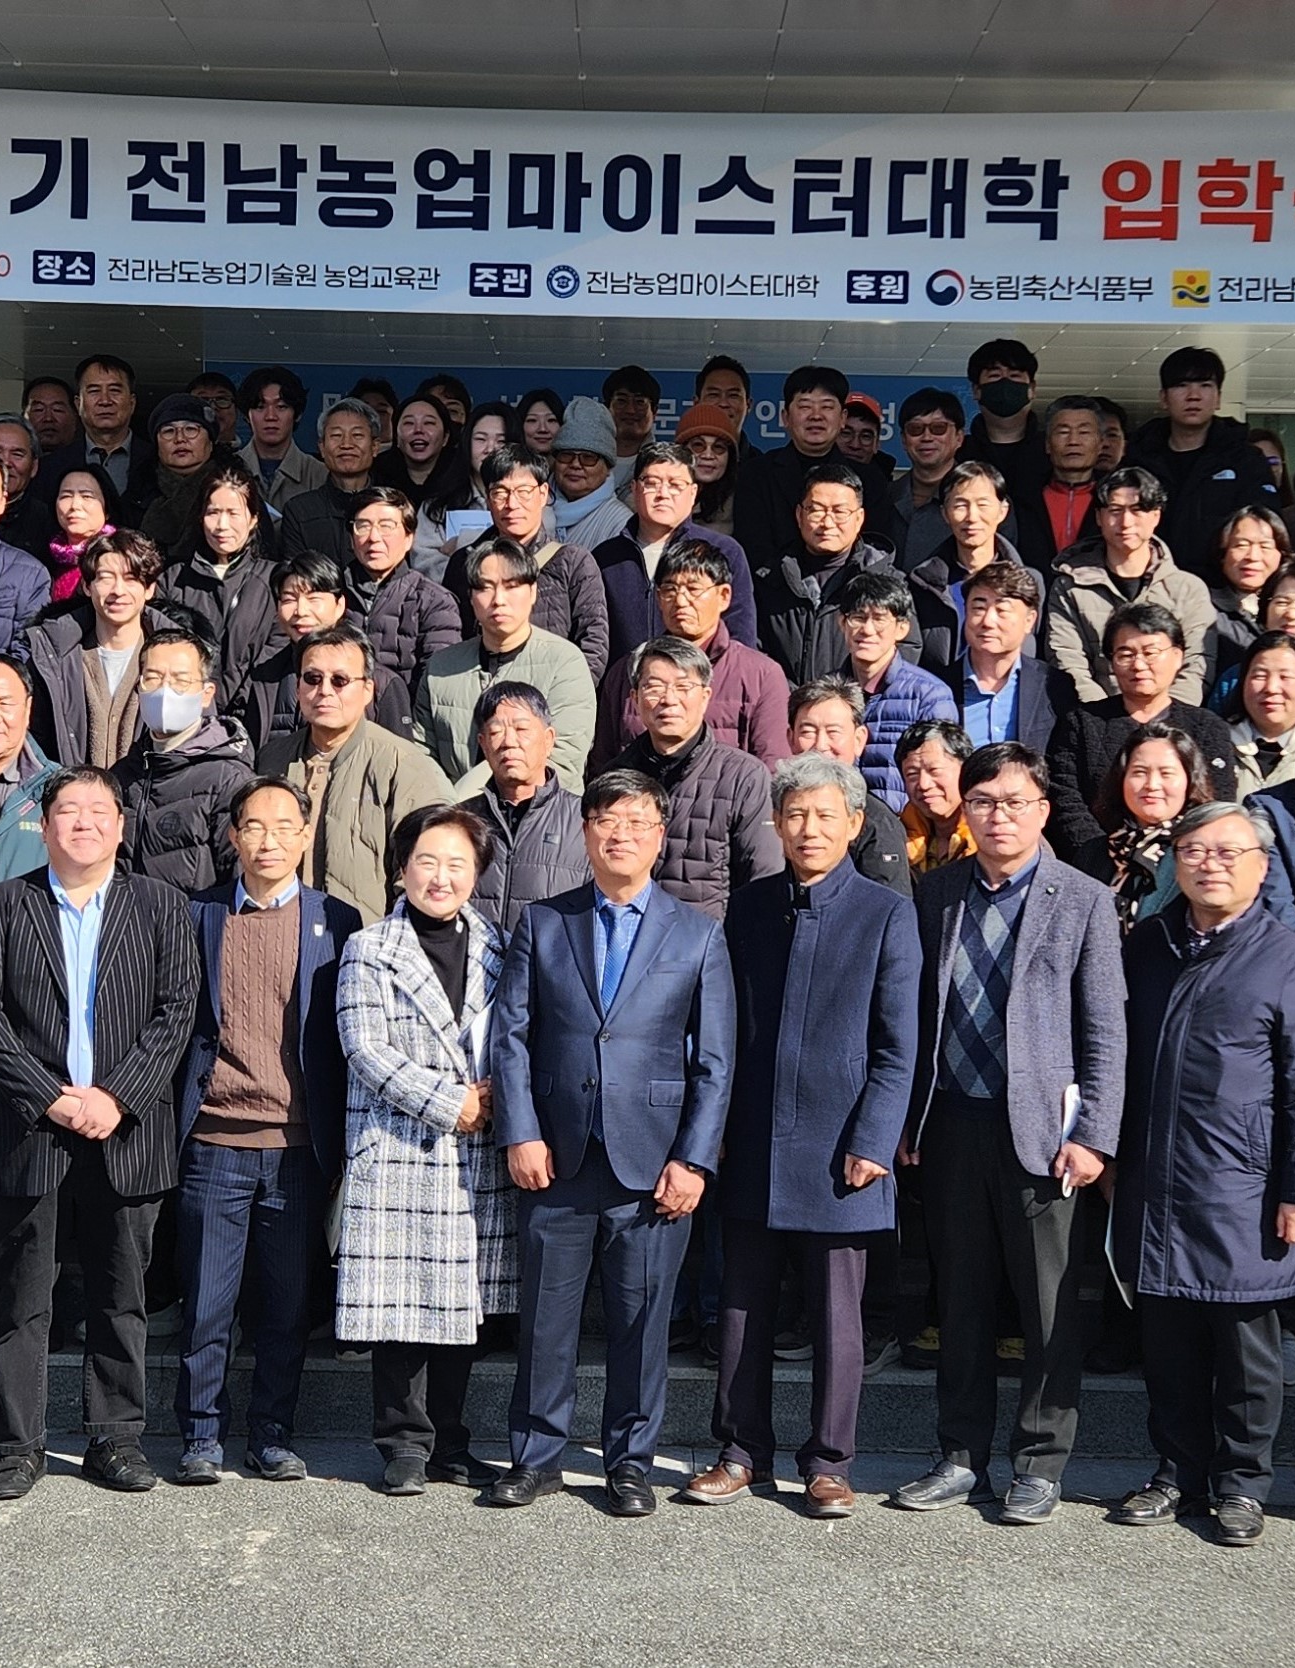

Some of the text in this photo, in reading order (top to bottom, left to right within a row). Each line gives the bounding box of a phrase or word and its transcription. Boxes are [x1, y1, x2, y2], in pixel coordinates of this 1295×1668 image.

[126, 140, 1070, 241] 전남농업마이스터대학
[37, 254, 441, 292] 장소 전라남도농업기술원 농업교육관
[472, 267, 529, 294] 주관
[586, 270, 820, 299] 전남농업마이스터대학
[849, 273, 906, 300] 후원
[968, 274, 1154, 303] 농림축산식품부
